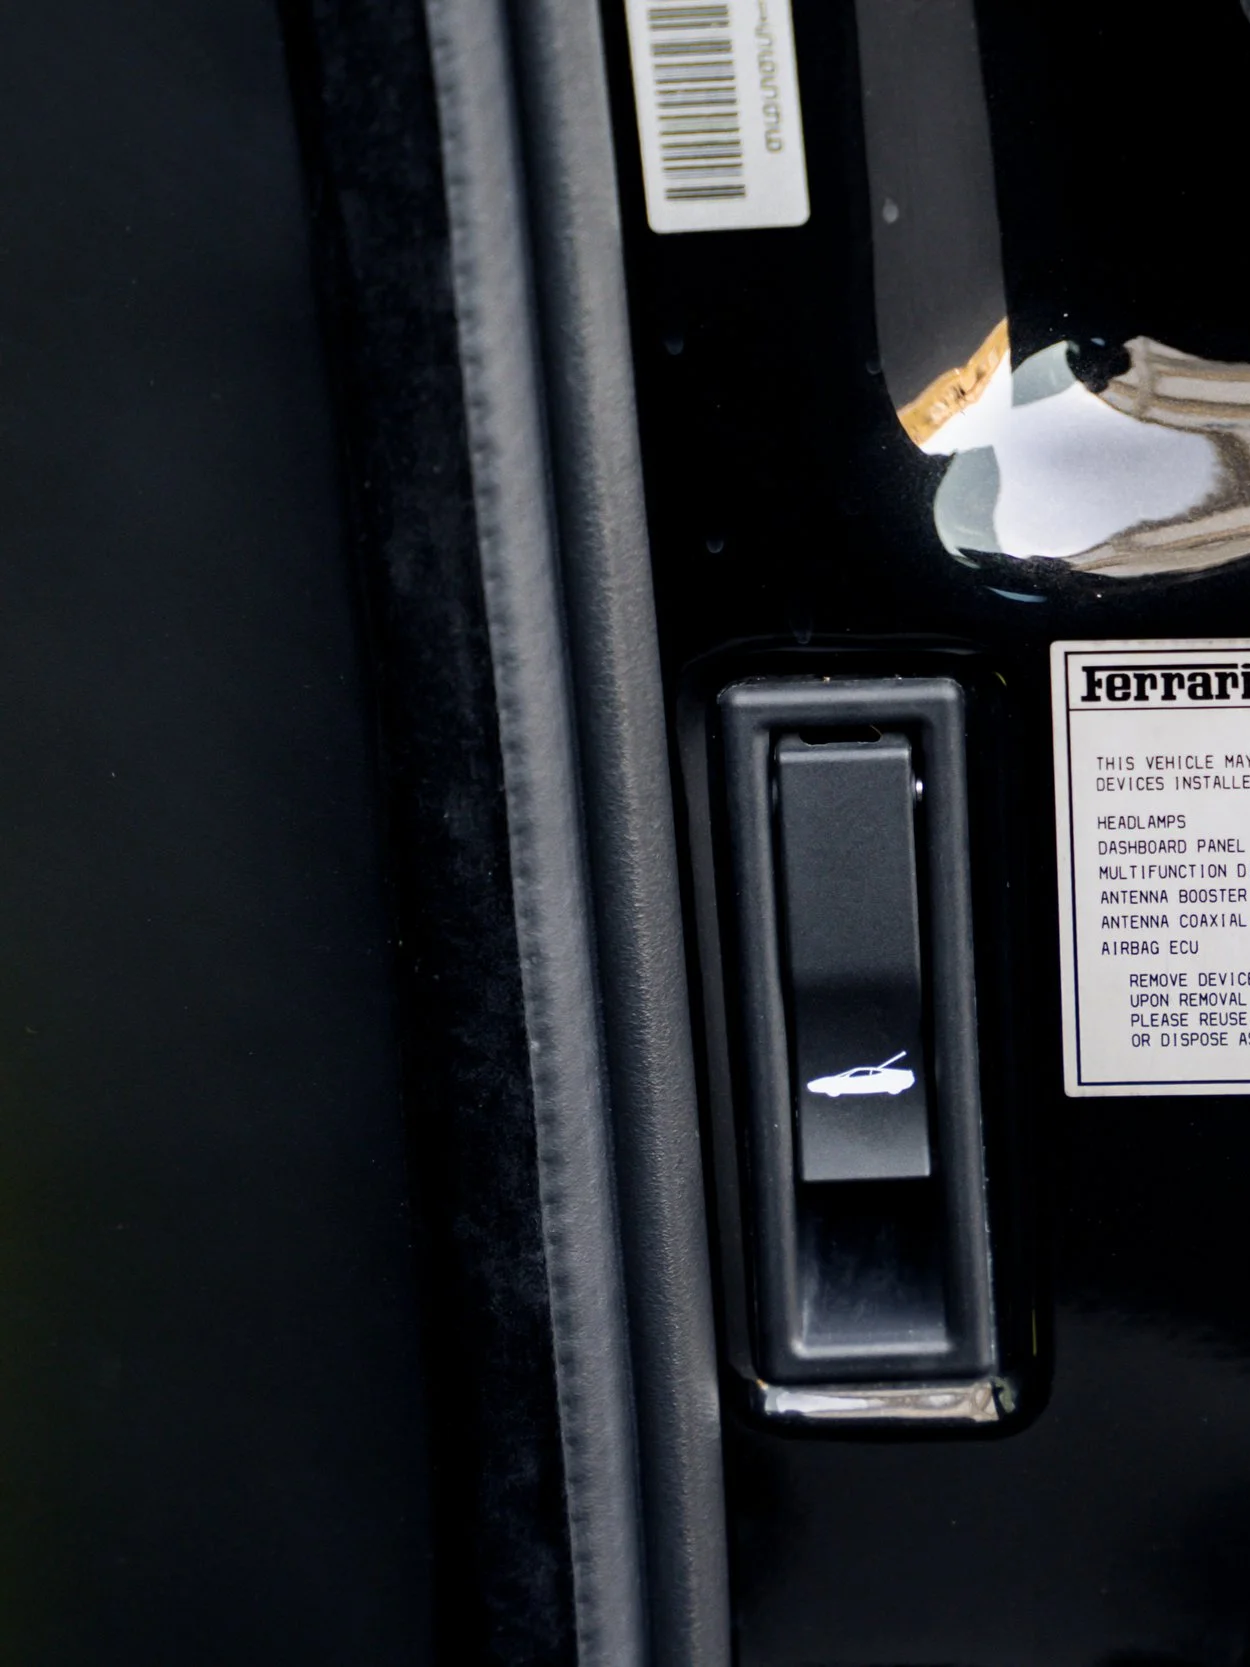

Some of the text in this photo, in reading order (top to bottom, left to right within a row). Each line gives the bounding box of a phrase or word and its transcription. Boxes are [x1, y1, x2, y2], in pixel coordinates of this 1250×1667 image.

[1096, 755, 1135, 771] THIS
[1145, 754, 1215, 771] VEHICLE
[1095, 775, 1165, 792] DEVICES
[1097, 814, 1187, 831] HEADLAMPS
[1097, 838, 1246, 856] DASHBOARD PANEL
[1098, 863, 1228, 881] MULTIFUNCTION
[1100, 887, 1248, 905] ANTENNA BOOSTER
[1101, 914, 1170, 930] ANTENNA
[1179, 912, 1248, 929] COAXIAL
[1101, 939, 1199, 956] AIRBAG ECU
[1129, 972, 1188, 989] REMOVE
[1129, 992, 1170, 1009] UPON
[1178, 991, 1248, 1008] REMOVAL
[1130, 1012, 1189, 1028] PLEASE
[1131, 1032, 1151, 1048] OR
[1160, 1031, 1229, 1048] DISPOSE
